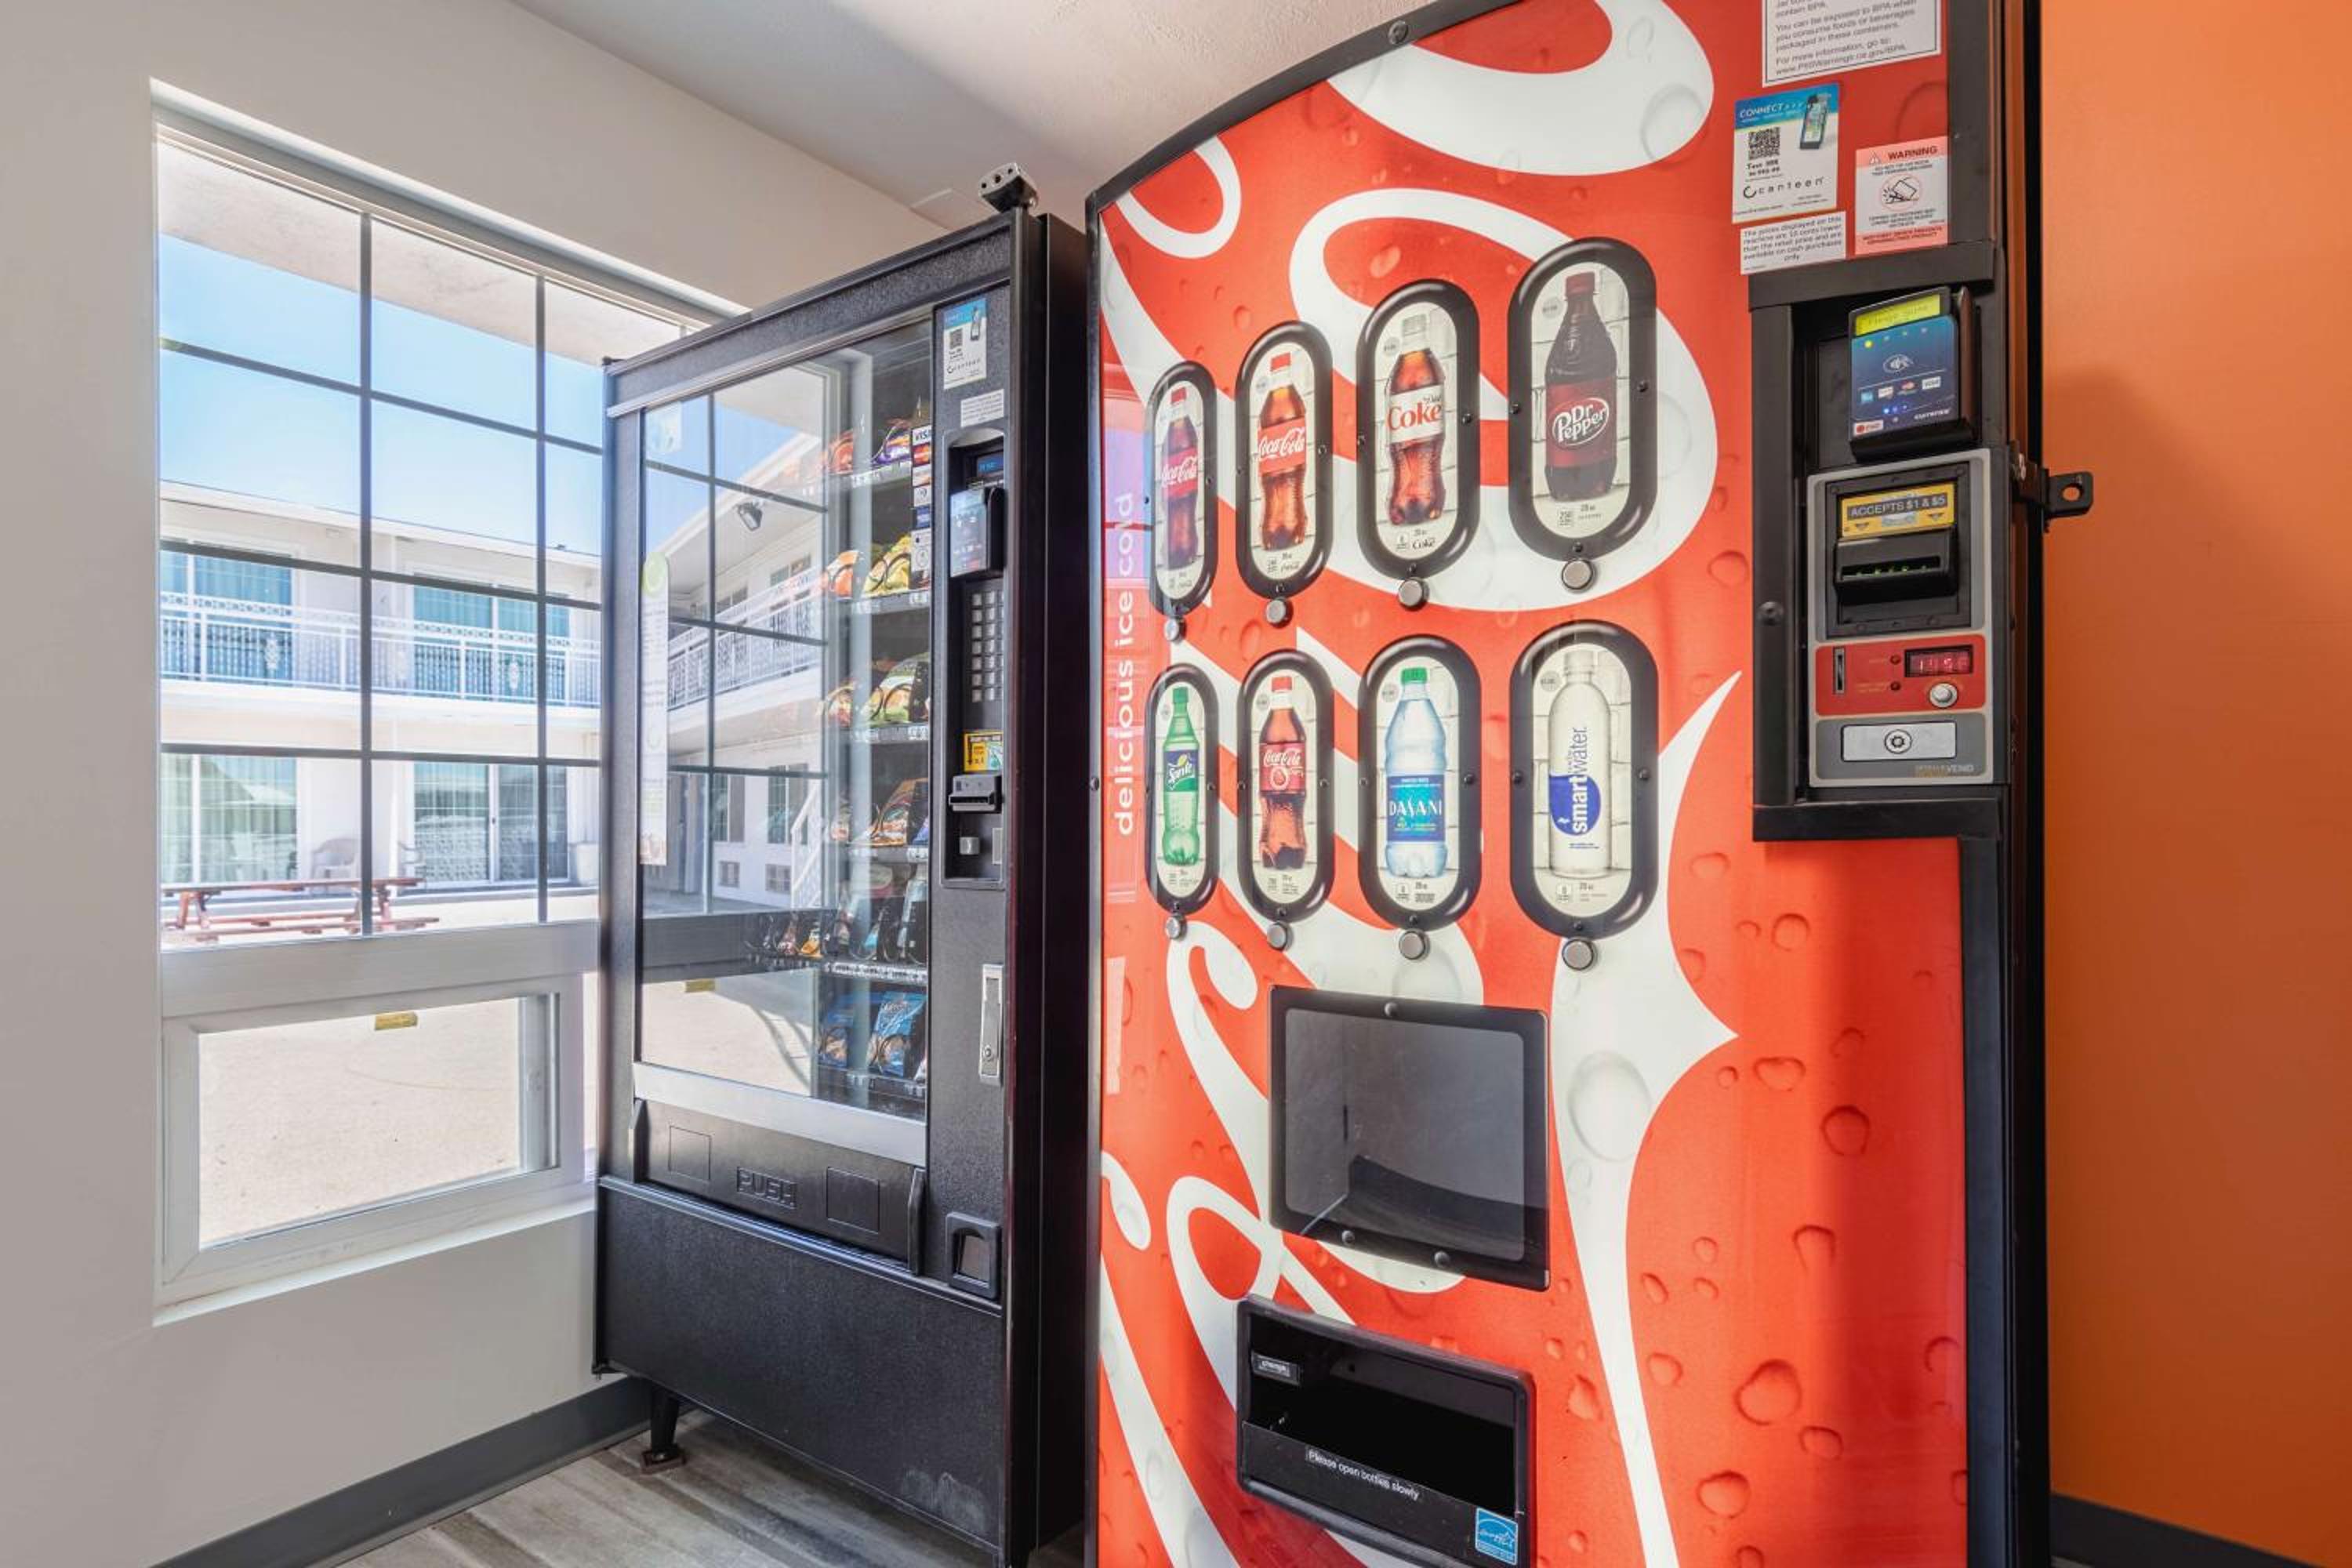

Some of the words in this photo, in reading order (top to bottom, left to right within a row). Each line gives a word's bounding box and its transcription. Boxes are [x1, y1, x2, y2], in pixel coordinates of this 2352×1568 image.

[1888, 146, 1937, 160] WARNING
[1388, 401, 1442, 430] Coke
[1555, 408, 1606, 442] Pepper
[1571, 404, 1593, 423] Dr
[1258, 426, 1305, 460] Coca-Cola
[1850, 501, 1905, 517] ACCEPTS
[1906, 496, 1919, 510] $1
[1922, 498, 1929, 508] &
[1931, 495, 1945, 507] $5
[1115, 492, 1134, 577] cold
[1114, 590, 1134, 647] ice
[1114, 659, 1134, 835] delicious
[1263, 748, 1302, 767] Coca-Cola
[1168, 760, 1195, 783] Sprite
[1388, 797, 1443, 817] DASANI
[737, 1167, 797, 1209] PUSH
[1308, 1449, 1337, 1468] Please
[1338, 1463, 1360, 1475] open
[1361, 1470, 1390, 1489] bottles
[1392, 1481, 1419, 1501] slowly
